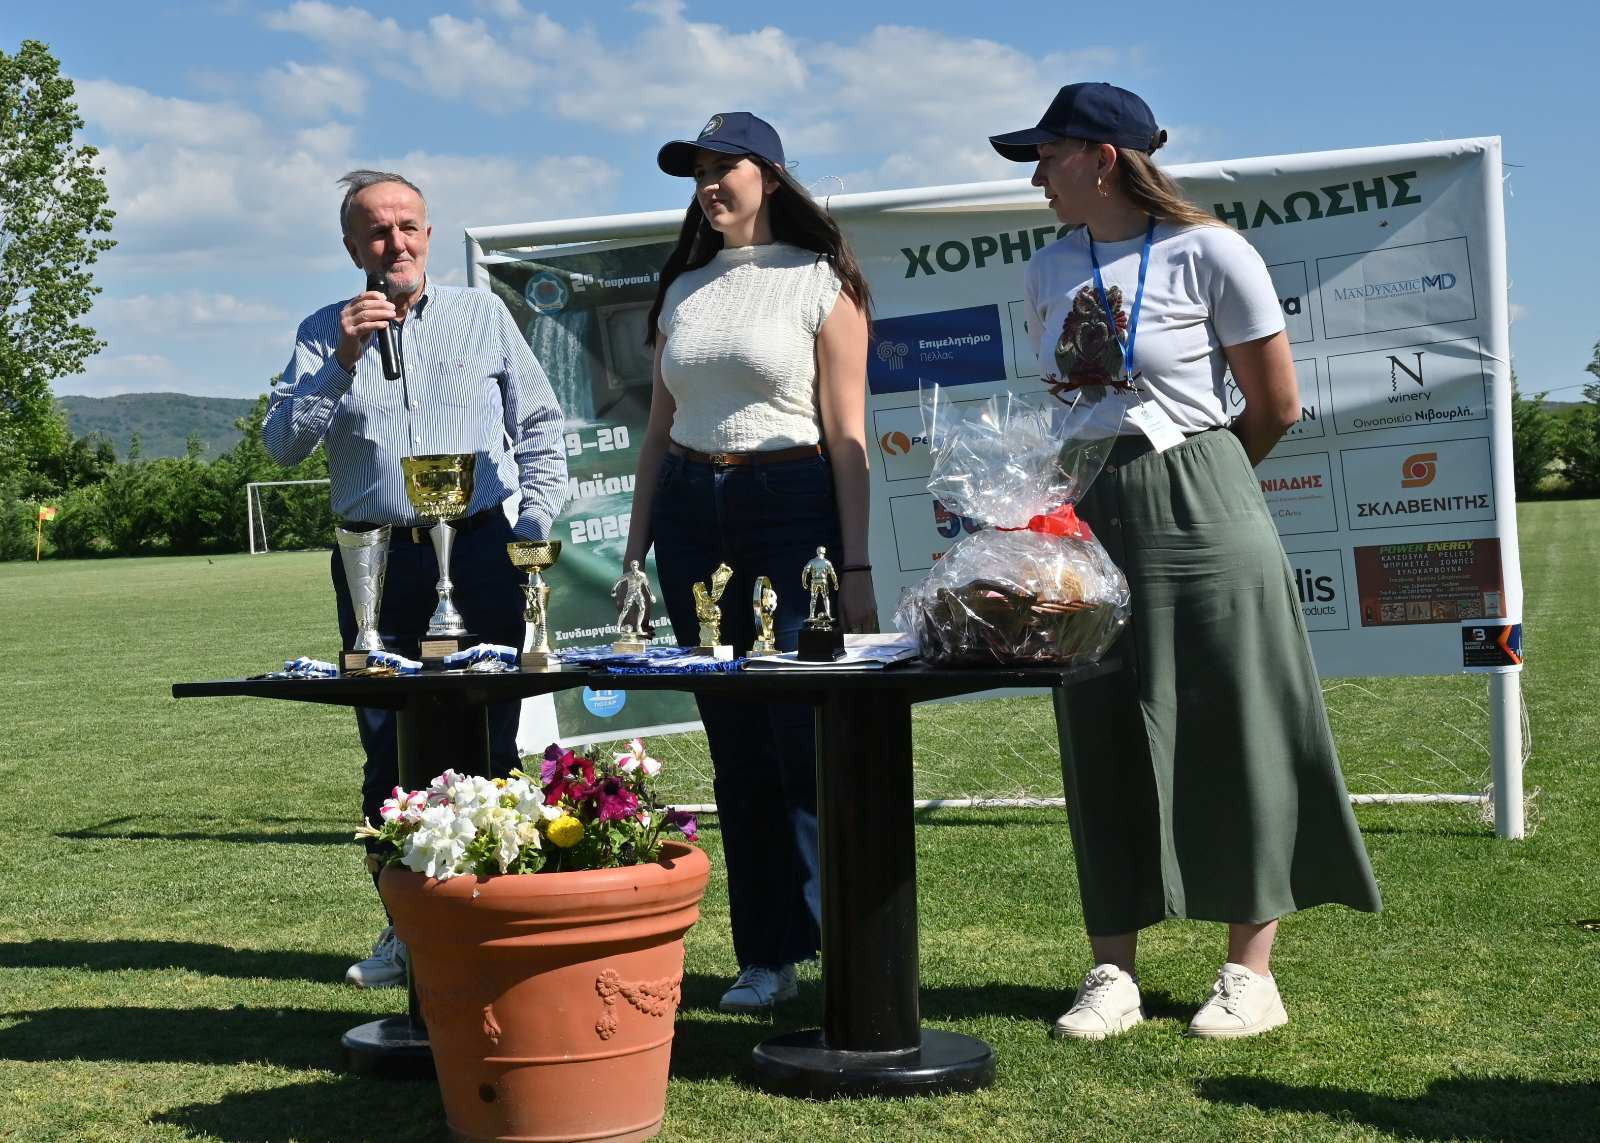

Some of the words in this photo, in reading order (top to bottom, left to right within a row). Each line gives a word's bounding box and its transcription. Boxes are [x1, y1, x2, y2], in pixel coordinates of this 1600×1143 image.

[901, 223, 1074, 278] ΧΟΡΗΓ
[919, 333, 990, 350] Επιμελητήριο
[919, 350, 955, 362] Πέλλας
[1386, 351, 1425, 391] N
[1388, 391, 1432, 405] winery
[1258, 475, 1324, 493] ΝΙΑΔΗΣ
[1356, 493, 1490, 519] ΣΚΛΑΒΕΝΙΤΗΣ
[1380, 544, 1424, 554] POWER
[1427, 541, 1474, 552] ENERGY
